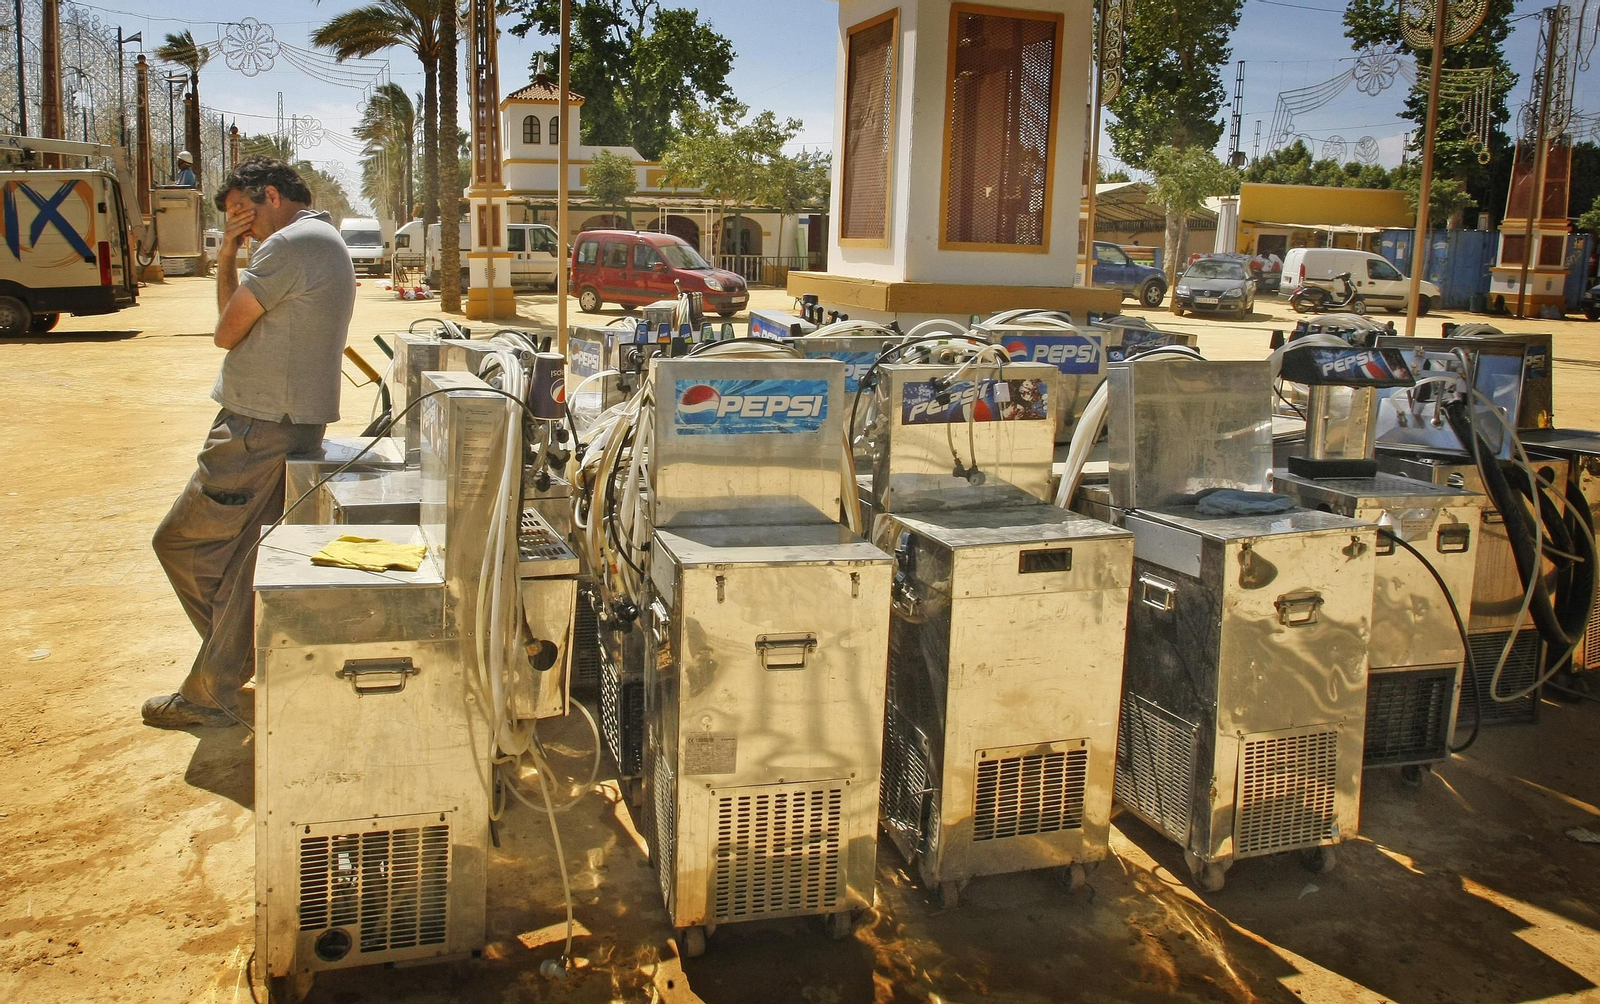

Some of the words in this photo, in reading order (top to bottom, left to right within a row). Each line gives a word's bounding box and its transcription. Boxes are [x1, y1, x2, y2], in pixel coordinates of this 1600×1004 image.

[578, 350, 600, 371] PEPSI
[1032, 344, 1097, 364] PEPSI
[1322, 350, 1374, 377] PEPSI
[1525, 354, 1546, 368] PSI
[716, 395, 824, 418] PEPSI
[908, 381, 990, 422] PEPSI
